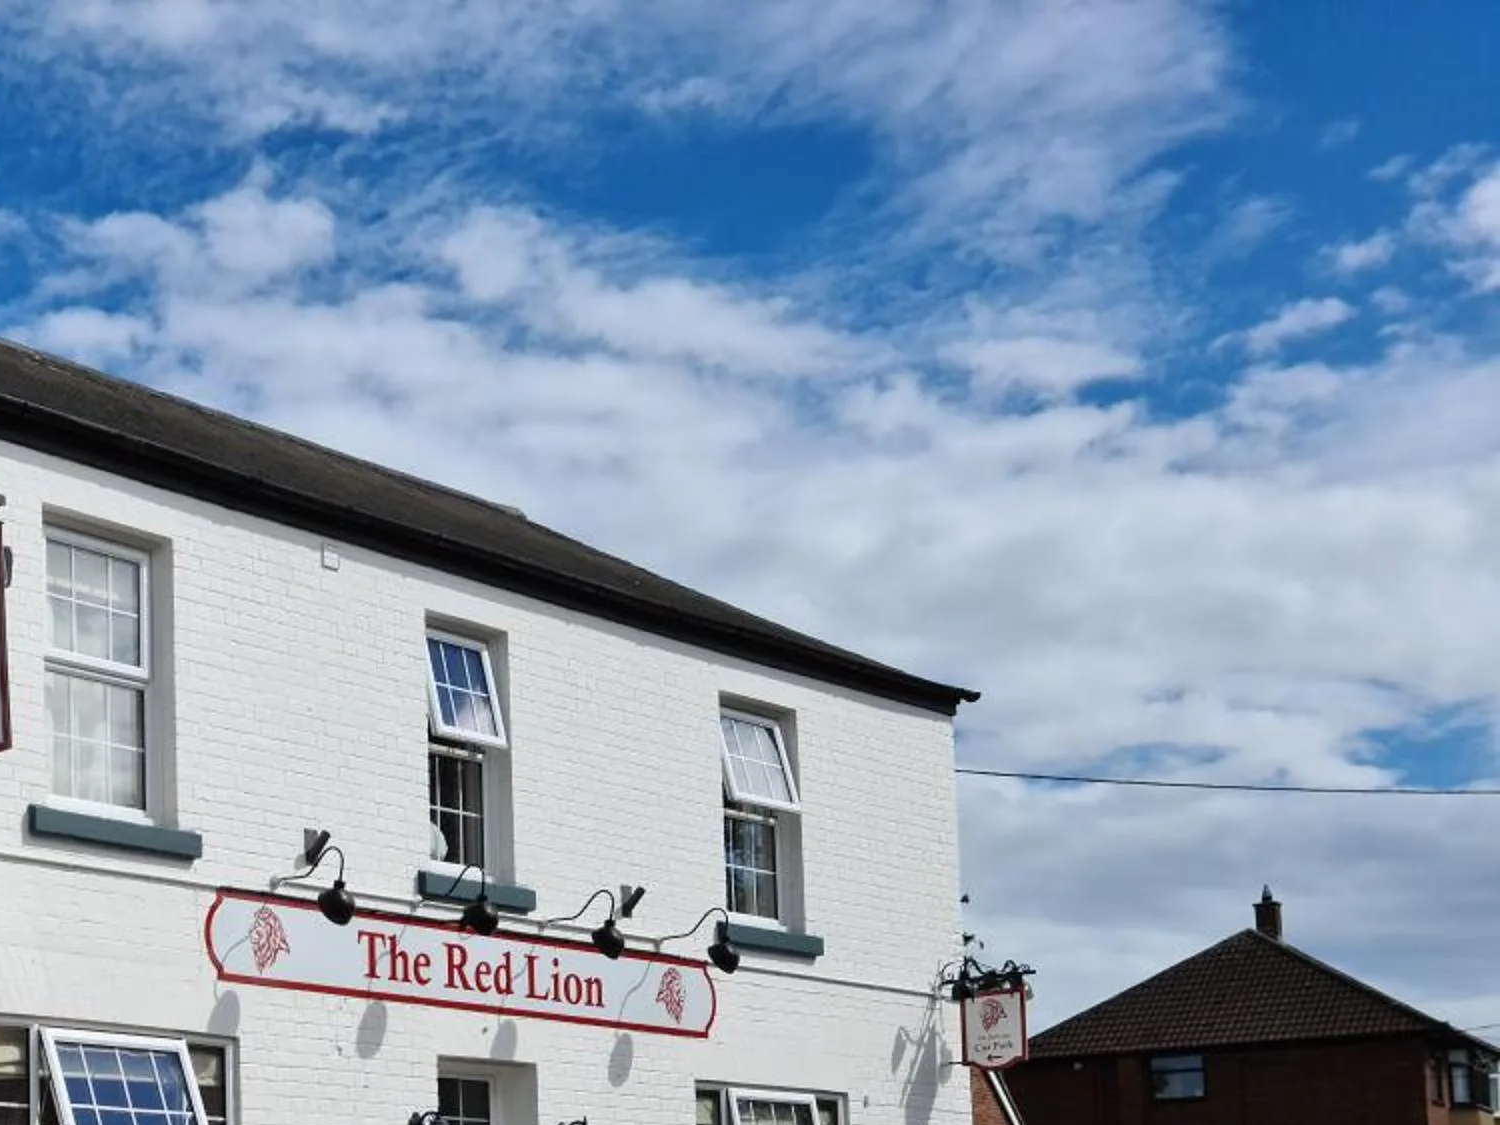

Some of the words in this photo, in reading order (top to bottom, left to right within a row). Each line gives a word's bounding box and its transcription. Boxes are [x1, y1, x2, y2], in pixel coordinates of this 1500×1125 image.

[357, 930, 433, 987] The
[442, 942, 514, 996] Red
[523, 954, 606, 1009] Lion
